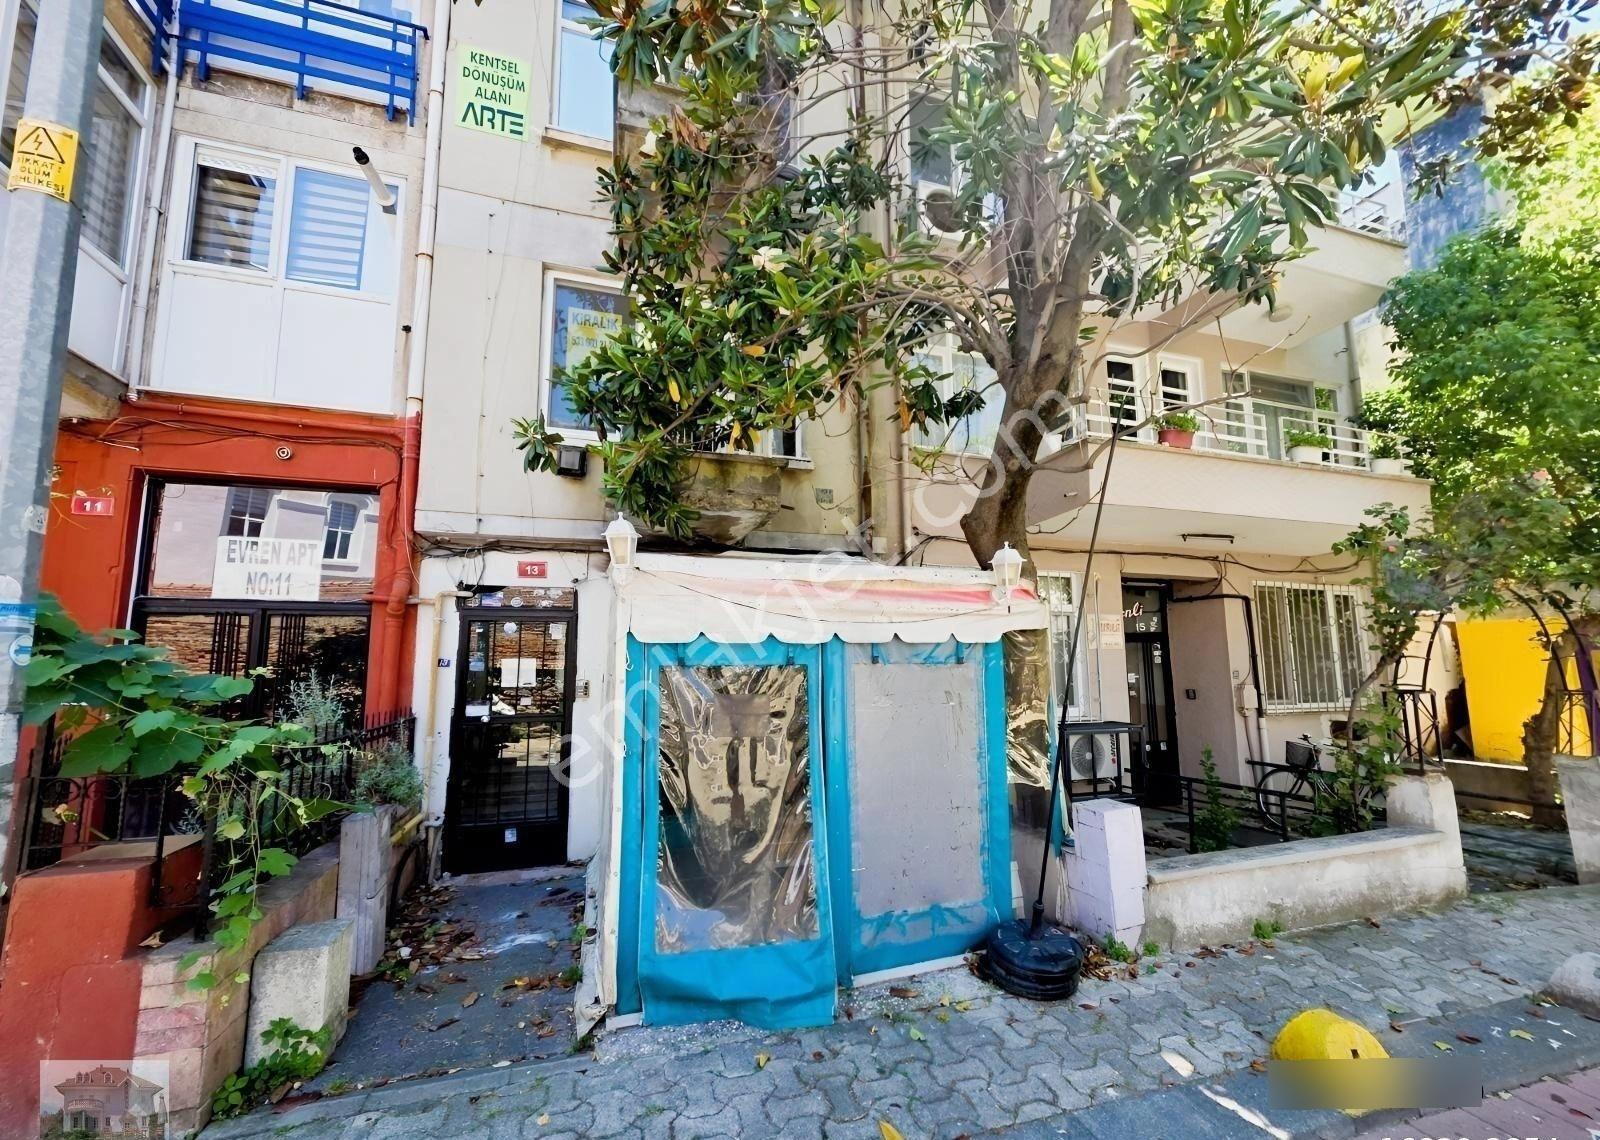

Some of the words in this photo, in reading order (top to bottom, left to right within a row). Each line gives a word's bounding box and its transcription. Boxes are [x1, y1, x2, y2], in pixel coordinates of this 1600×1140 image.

[470, 51, 520, 75] KENTSEL
[462, 65, 526, 92] DÖNÜŞÜM
[474, 86, 512, 106] ALANI
[461, 101, 524, 136] ARTE
[83, 500, 103, 512] 11
[227, 539, 282, 564] EVREN
[286, 541, 318, 566] APT
[525, 565, 539, 575] 13
[246, 571, 292, 596] NO:11
